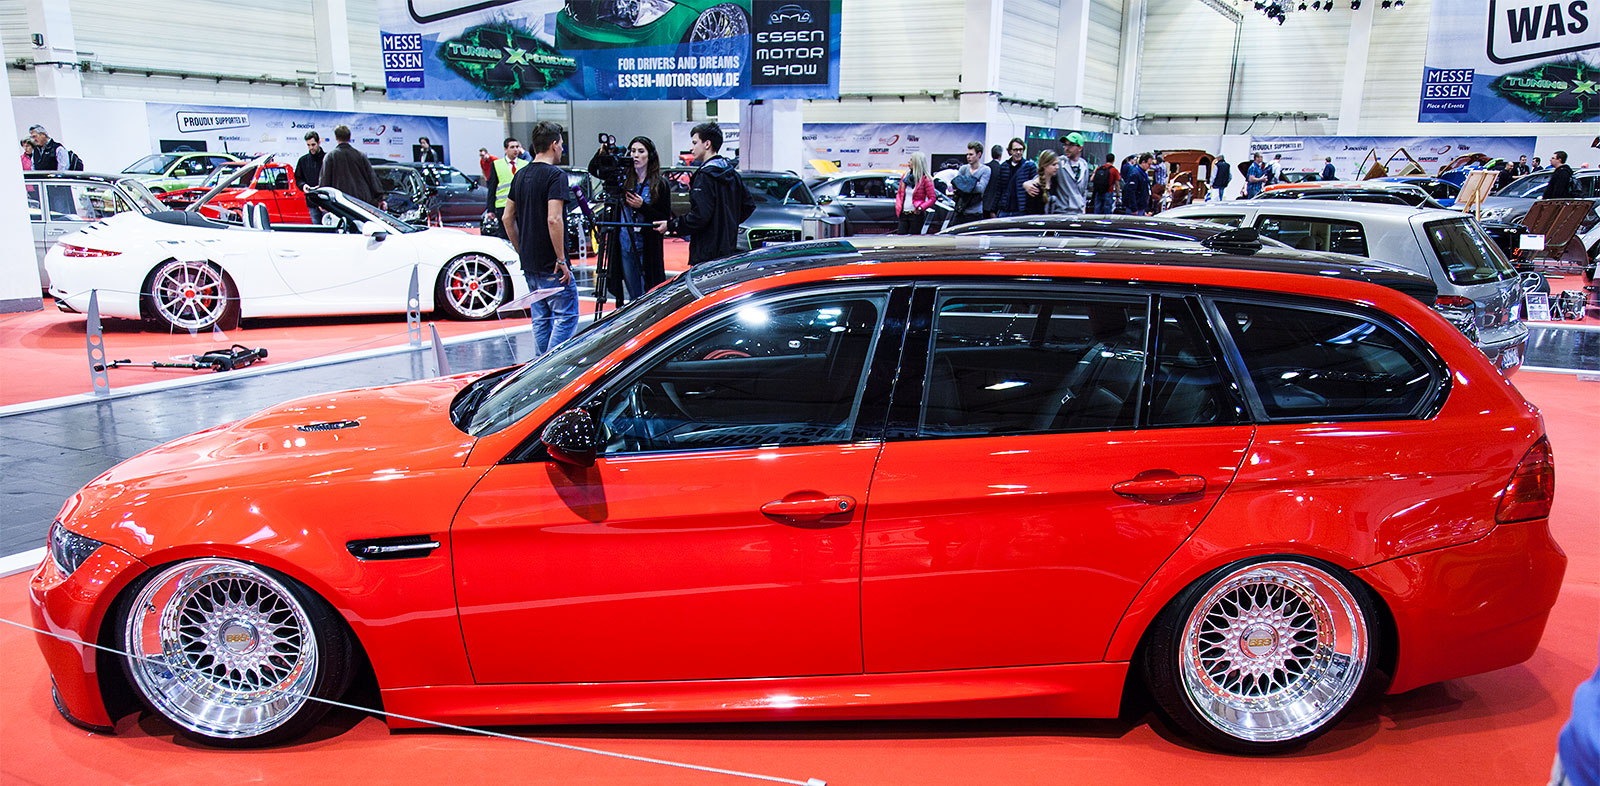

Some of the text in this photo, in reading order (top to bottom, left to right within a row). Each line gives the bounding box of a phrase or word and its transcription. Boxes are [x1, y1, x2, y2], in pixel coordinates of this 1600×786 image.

[1507, 0, 1589, 44] WAS
[383, 35, 421, 50] MESSE
[756, 30, 825, 43] ESSEN
[448, 43, 502, 59] TUNING
[756, 47, 825, 60] MOTOR
[384, 53, 422, 68] ESSEN
[618, 55, 740, 70] FOR DRIVERS AND DREAMS
[761, 64, 817, 76] SHOW
[1428, 70, 1473, 82] MESSE
[618, 72, 740, 88] ESSEN-MOTORSHOW.DE
[1505, 76, 1568, 90] TUNING
[1426, 85, 1470, 97] ESSEN
[183, 116, 214, 127] PROUDLY
[215, 116, 241, 125] SUPPORTED
[1248, 638, 1272, 647] BBS
